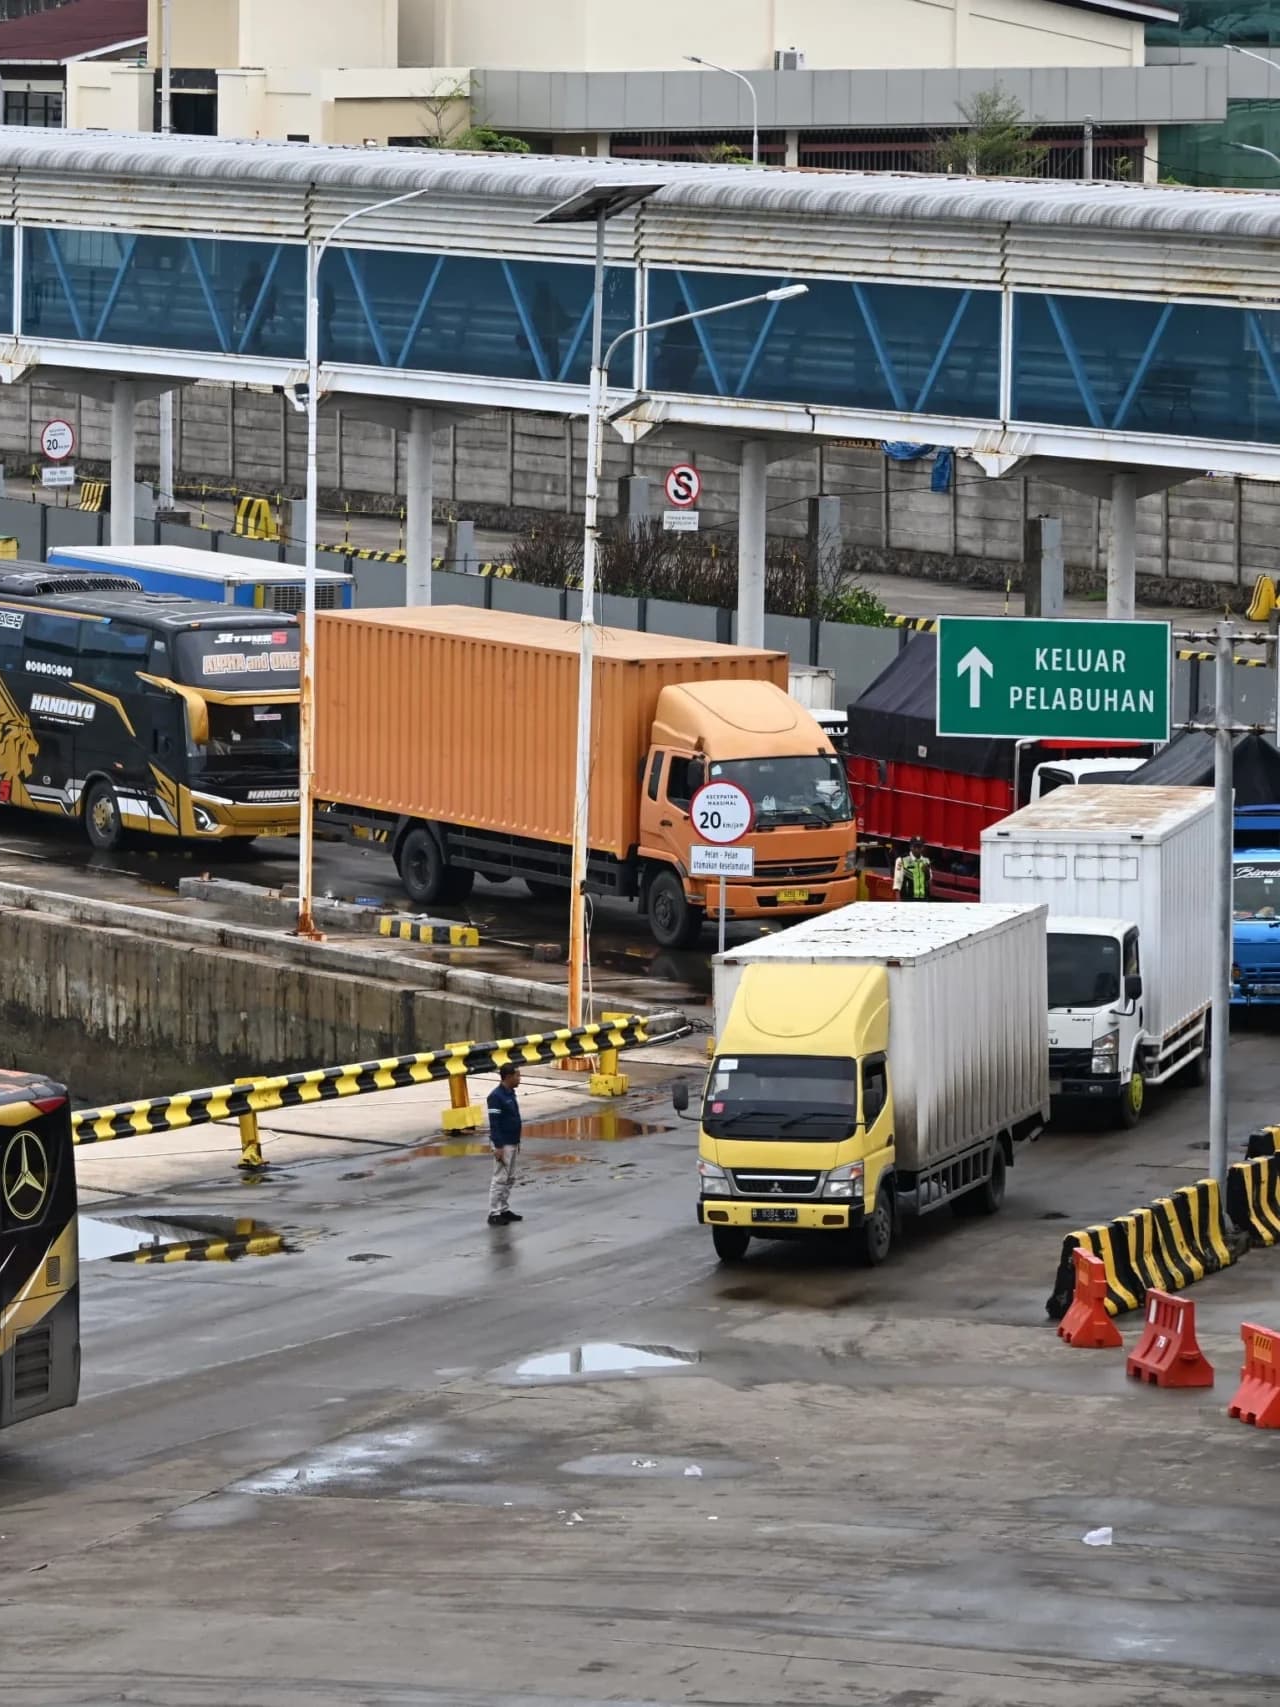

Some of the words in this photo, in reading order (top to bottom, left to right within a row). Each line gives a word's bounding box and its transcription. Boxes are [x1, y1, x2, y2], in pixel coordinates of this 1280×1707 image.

[46, 439, 58, 450] 20
[204, 654, 245, 674] ALPHA
[247, 653, 269, 670] and
[1035, 648, 1126, 673] KELUAR
[30, 693, 96, 720] HANDOYO
[1010, 686, 1154, 713] PELABUHAN
[700, 812, 722, 828] 20
